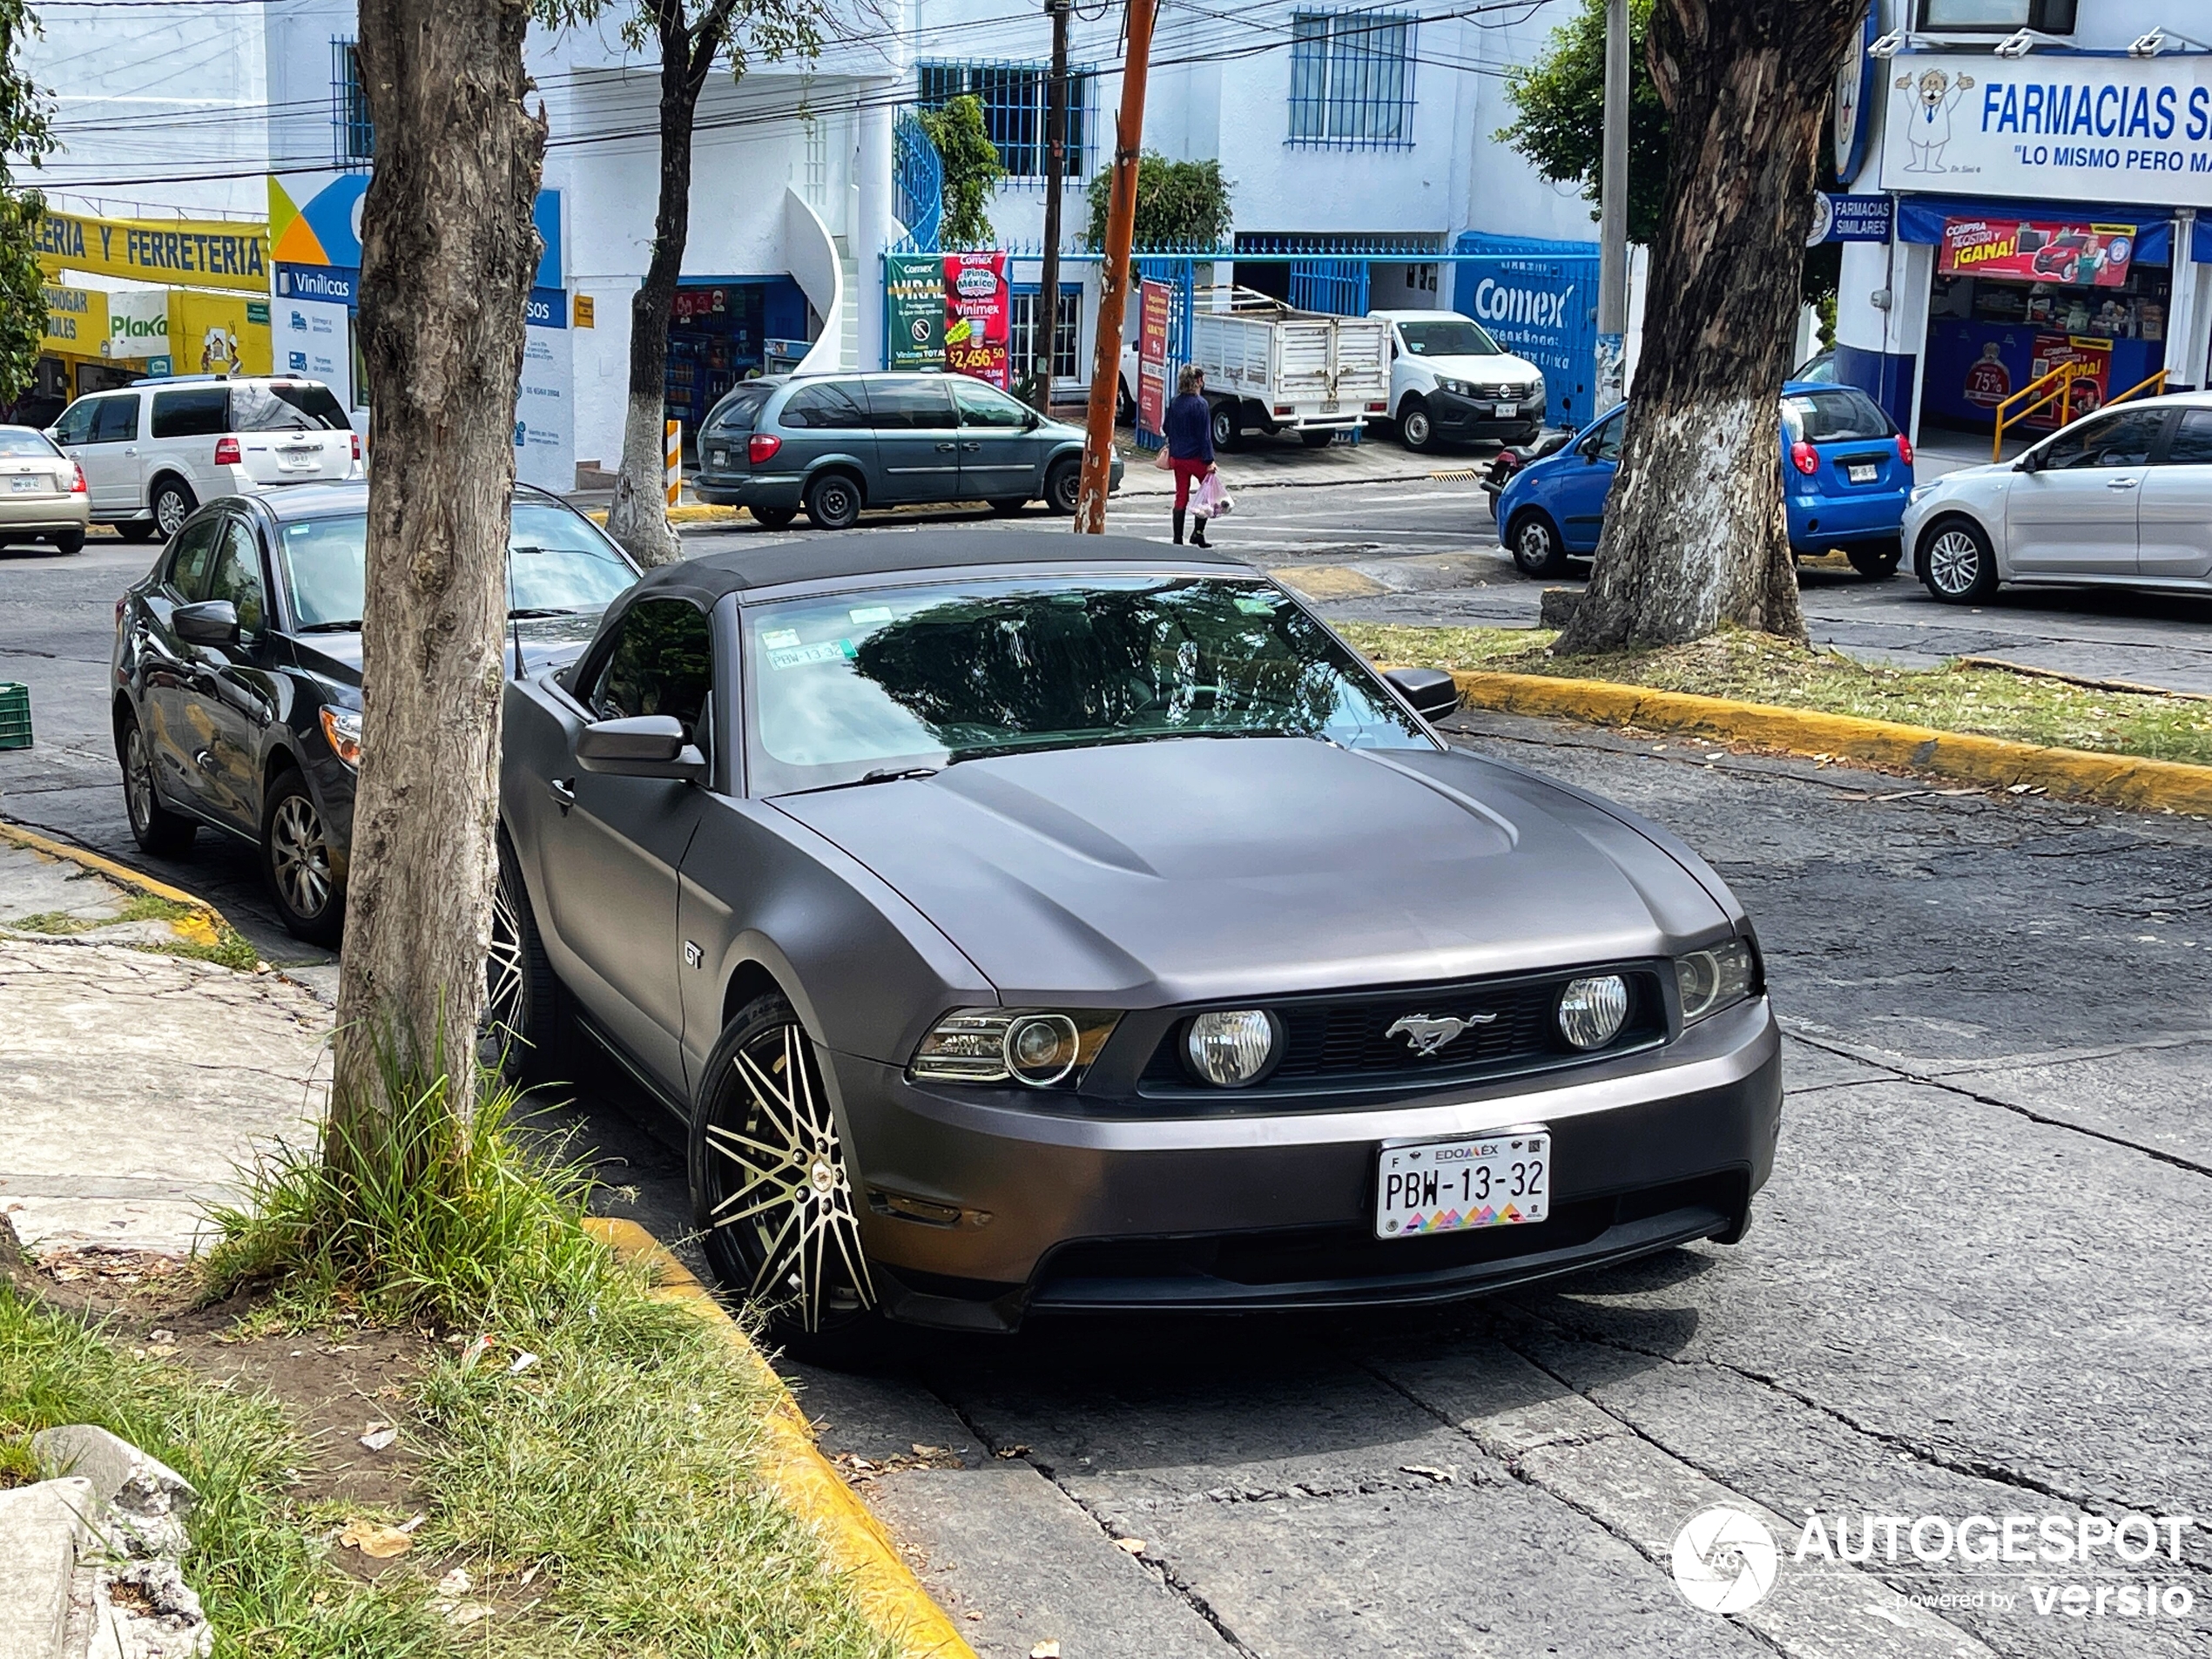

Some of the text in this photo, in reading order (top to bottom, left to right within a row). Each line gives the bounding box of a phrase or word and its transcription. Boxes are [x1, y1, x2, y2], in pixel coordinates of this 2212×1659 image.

[1981, 83, 2212, 141] FARMACIAS S
[2053, 146, 2120, 169] MISMO
[2126, 149, 2184, 172] PERO
[1834, 201, 1890, 217] FARMACIAS
[1836, 219, 1886, 235] SIMILARES
[1946, 221, 1986, 237] COMPRA
[1952, 230, 2002, 248] REGISTRA Y
[98, 225, 112, 261] Y
[127, 229, 265, 277] FERRETERIA
[960, 254, 995, 266] Comex
[1952, 235, 2016, 270] ¡GANA!
[903, 263, 935, 274] Comex
[294, 272, 349, 297] Vinílicas
[893, 279, 947, 300] VIRAL
[958, 278, 996, 289] México!
[954, 303, 1000, 315] Vinimex
[1475, 277, 1575, 329] Comex
[111, 314, 168, 337] Plaka
[923, 348, 947, 357] TOTAL
[1975, 372, 2002, 394] 75%
[684, 940, 705, 969] GT
[1392, 1157, 1399, 1168] F
[1386, 1160, 1543, 1211] PBW-13-32
